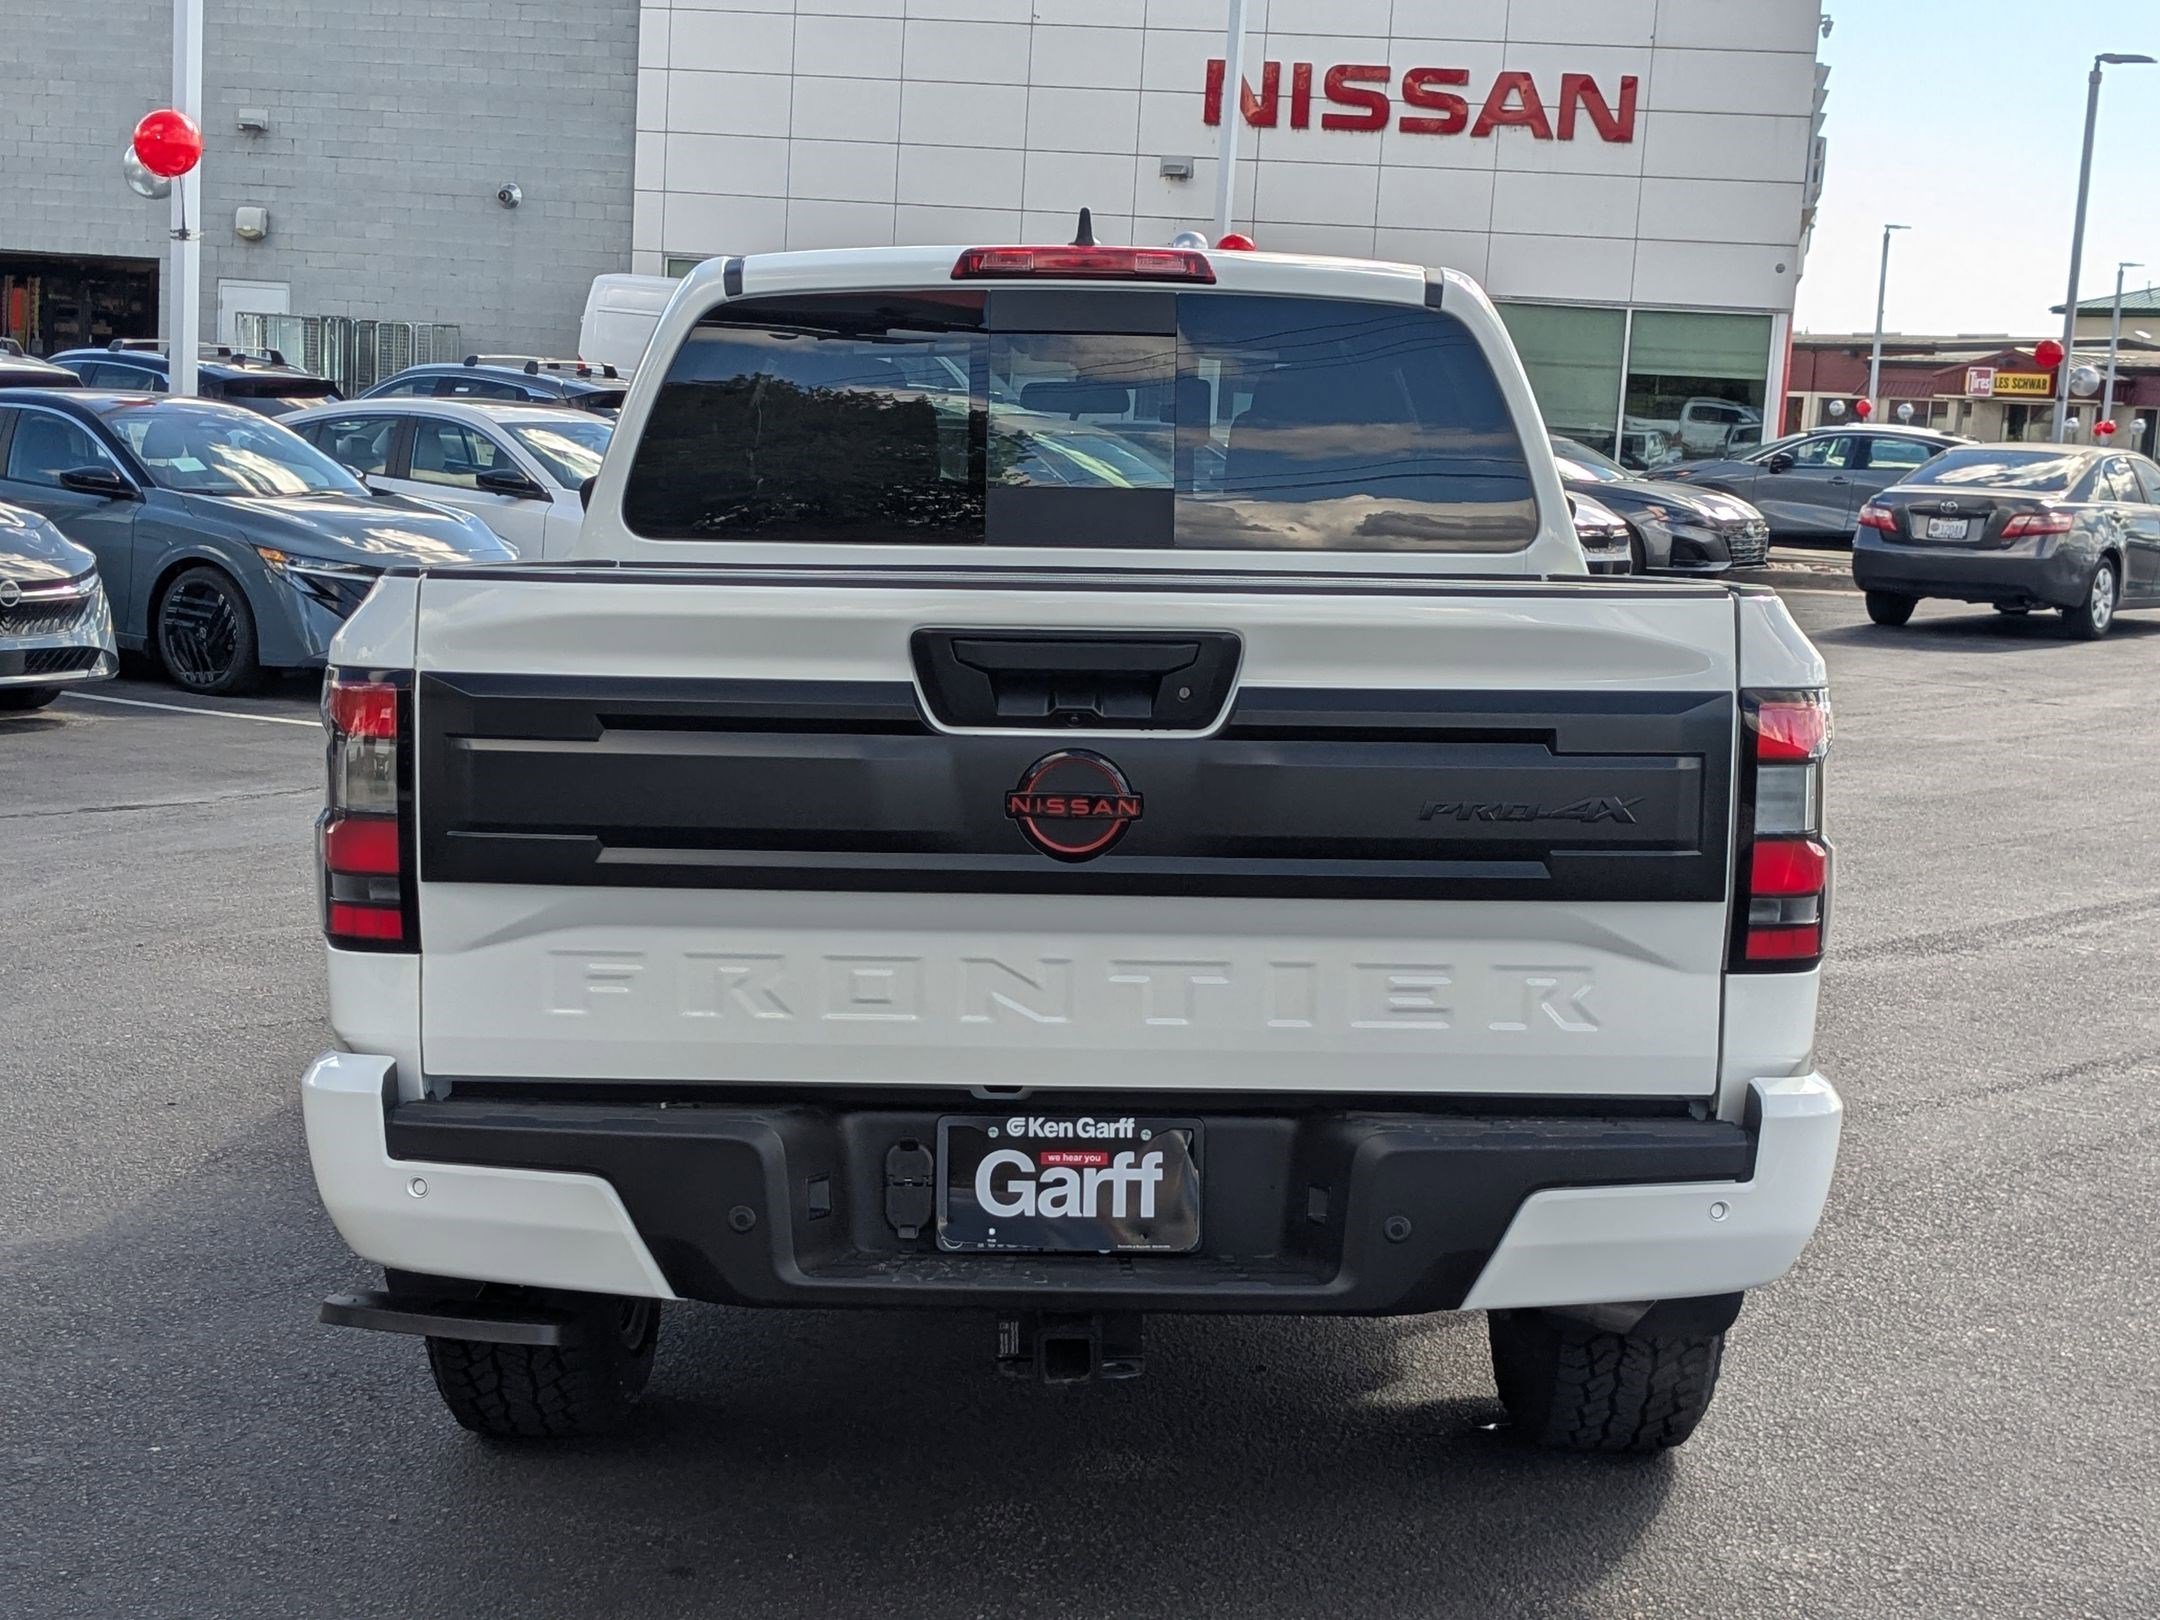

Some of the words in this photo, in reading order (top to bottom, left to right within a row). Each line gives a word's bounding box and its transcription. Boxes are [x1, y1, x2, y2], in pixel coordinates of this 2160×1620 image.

[1203, 59, 1638, 143] NISSAN
[1995, 376, 2009, 389] LES
[2011, 377, 2048, 390] SCHWAB
[1010, 797, 1138, 815] NISSAN
[1418, 795, 1647, 824] PRO-4X
[542, 947, 1600, 1032] FRONTIER
[1028, 1117, 1073, 1138] Ken
[1077, 1117, 1135, 1138] Garff
[1047, 1154, 1061, 1162] we
[1063, 1153, 1082, 1162] hear
[1084, 1154, 1101, 1164] you
[975, 1149, 1163, 1218] Garff
